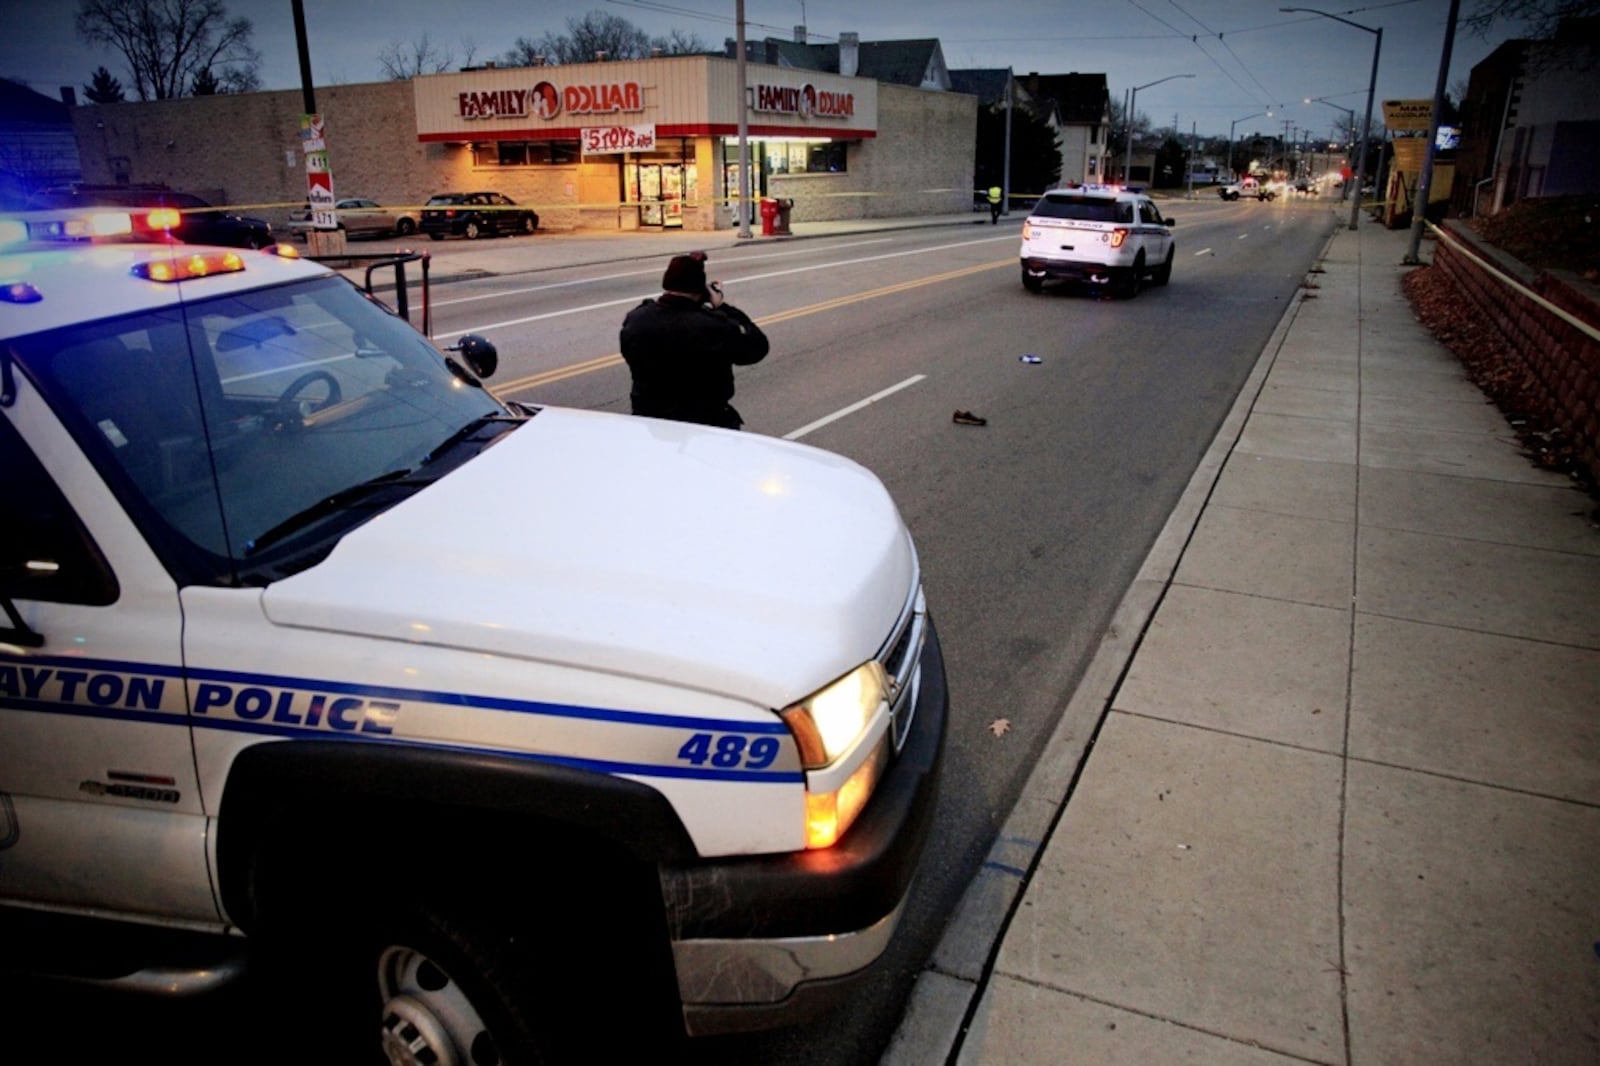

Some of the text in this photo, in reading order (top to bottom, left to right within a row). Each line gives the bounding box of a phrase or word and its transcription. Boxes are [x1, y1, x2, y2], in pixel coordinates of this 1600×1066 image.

[459, 82, 640, 116] FAMILY DOLLAR
[758, 84, 854, 116] FAMILY DOLLAR
[194, 683, 401, 734] POLICE
[678, 733, 780, 769] 489
